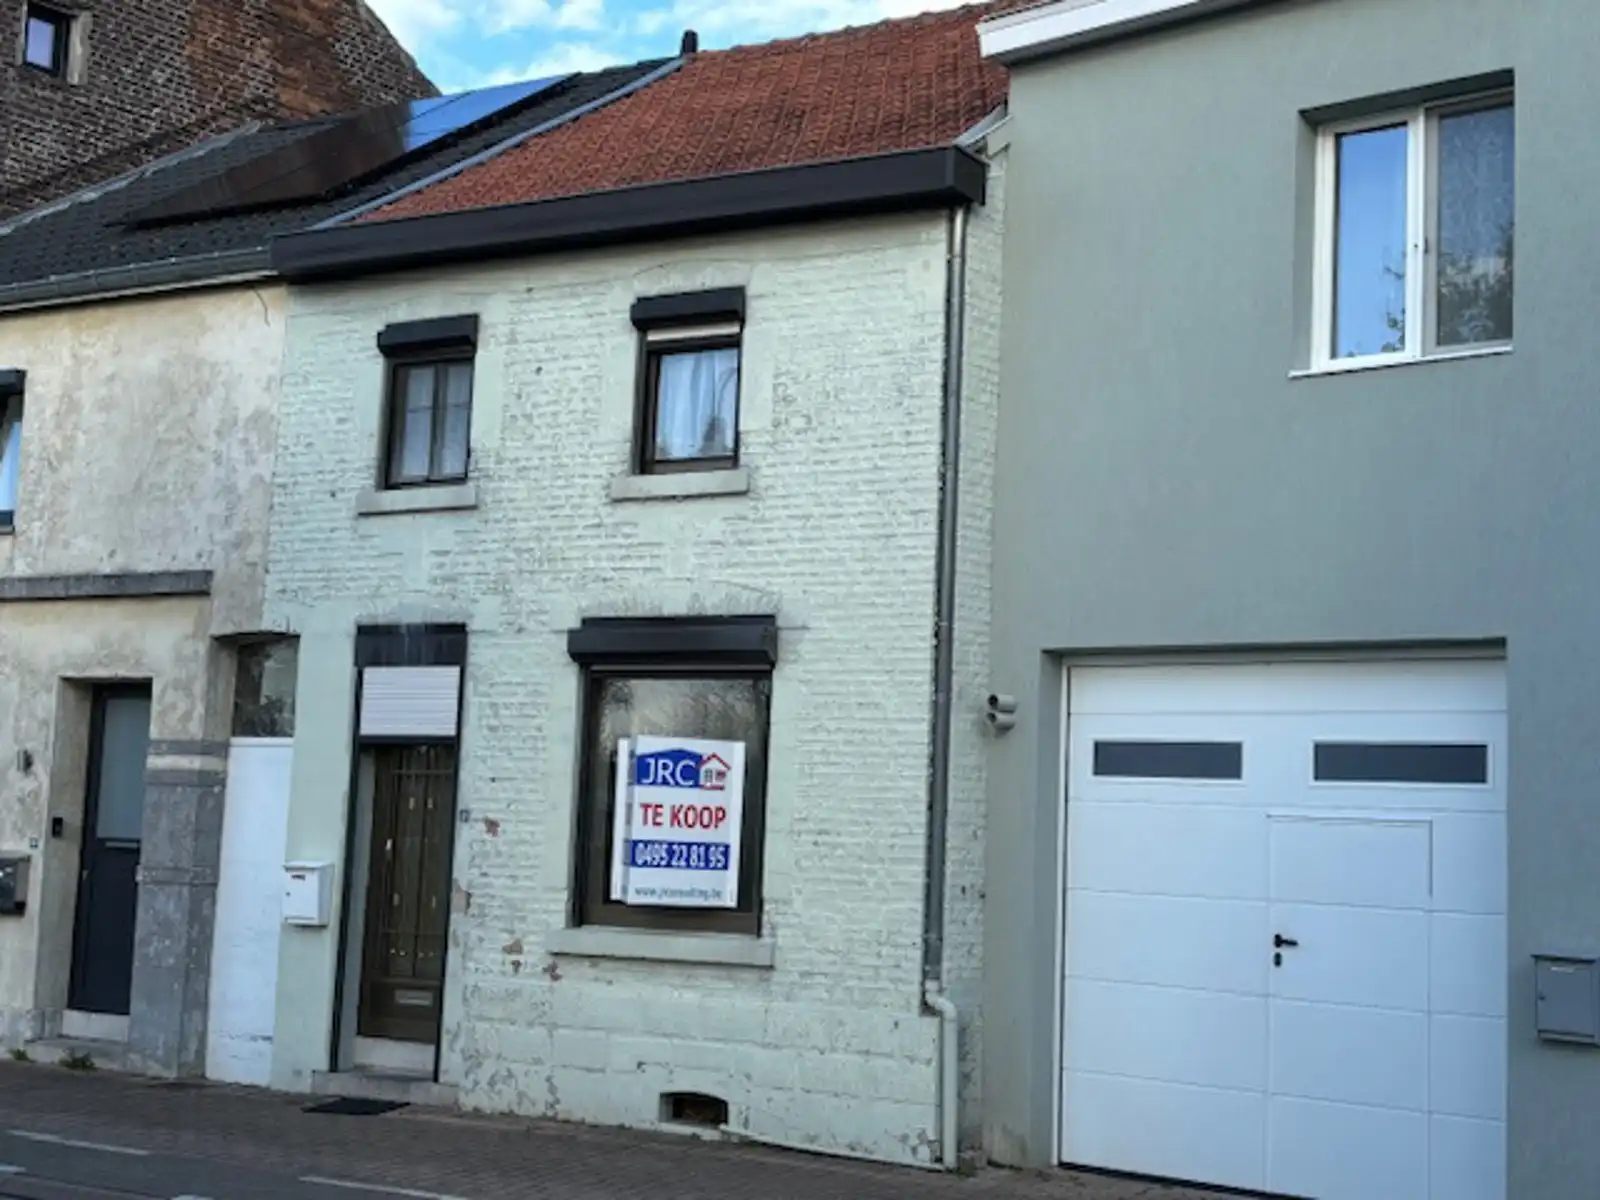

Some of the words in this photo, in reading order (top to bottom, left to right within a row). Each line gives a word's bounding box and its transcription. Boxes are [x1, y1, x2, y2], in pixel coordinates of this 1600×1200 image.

[641, 757, 696, 786] JRC
[640, 803, 663, 826] TE
[669, 804, 726, 829] KOOP
[635, 842, 669, 867] 0495
[671, 843, 688, 866] 22
[690, 844, 706, 868] 81
[708, 845, 726, 870] 95
